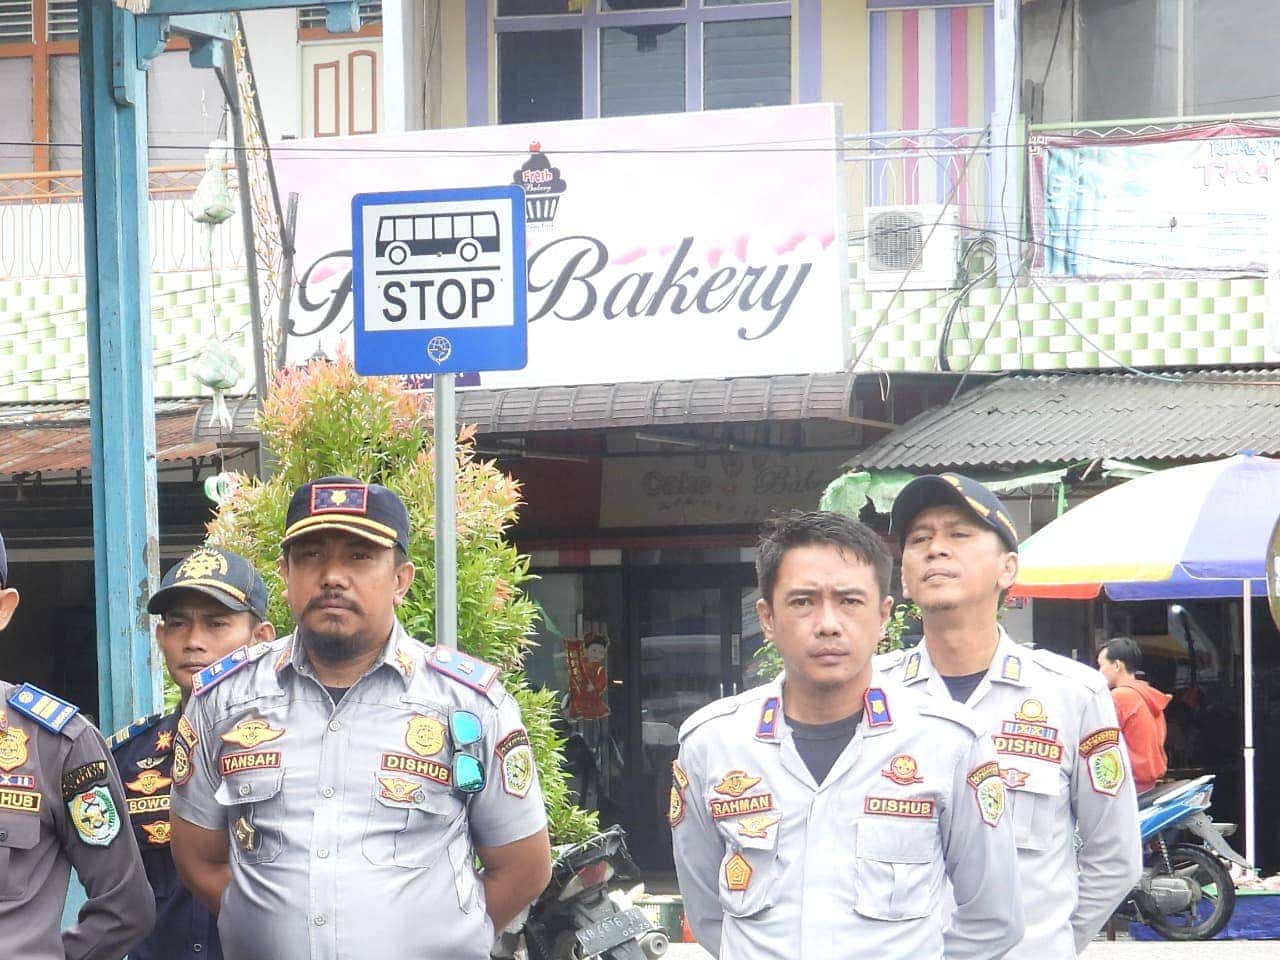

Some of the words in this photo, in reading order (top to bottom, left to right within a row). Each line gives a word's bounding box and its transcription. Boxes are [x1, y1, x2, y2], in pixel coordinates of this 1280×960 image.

[527, 235, 812, 340] Bakery
[382, 277, 495, 322] STOP
[994, 738, 1061, 760] DISHUB
[223, 754, 277, 771] YANSAH
[386, 756, 449, 780] DISHUB
[713, 795, 770, 815] RAHMAN
[869, 799, 932, 815] DISHUB
